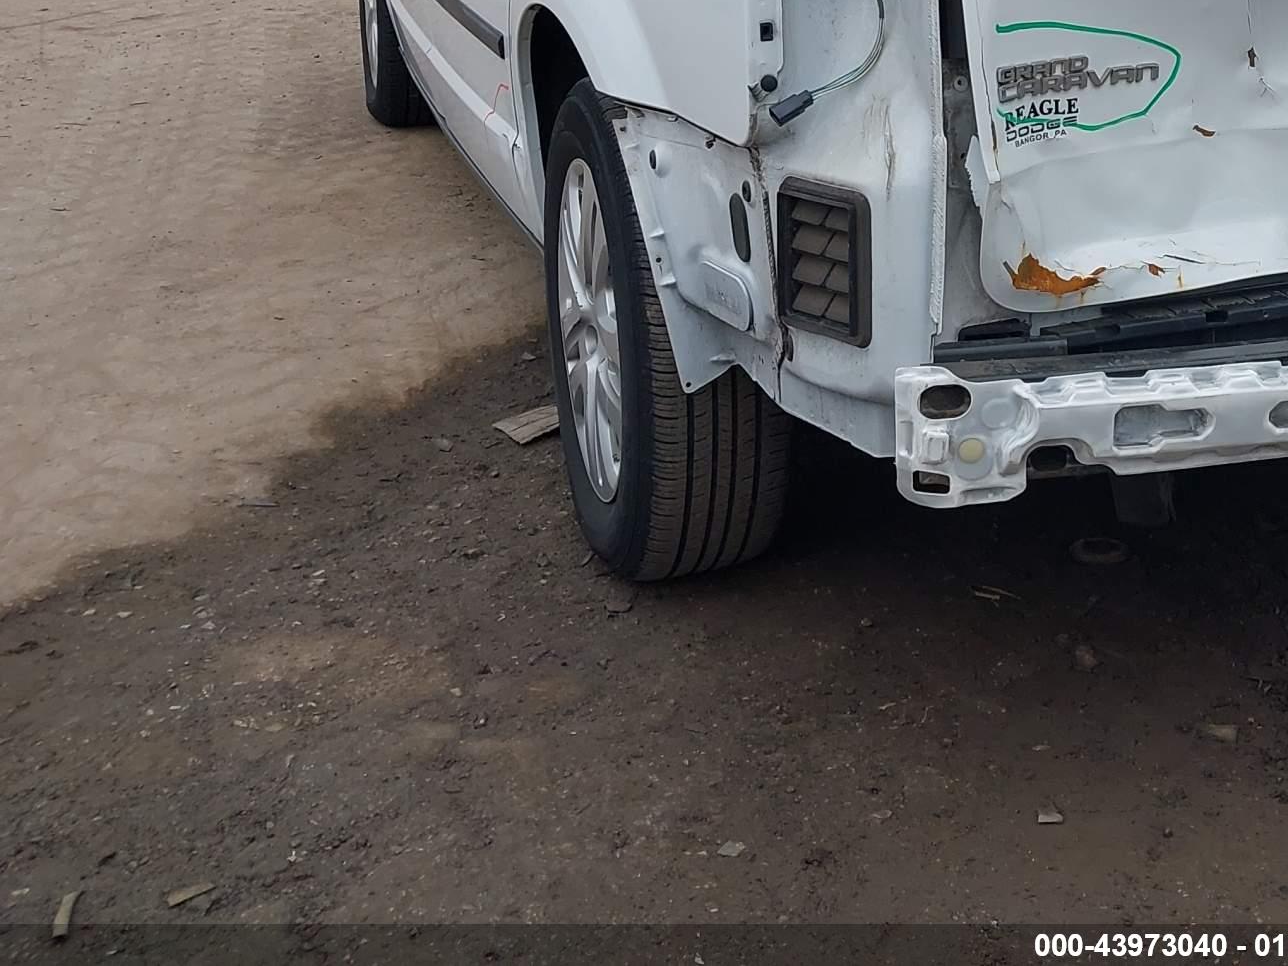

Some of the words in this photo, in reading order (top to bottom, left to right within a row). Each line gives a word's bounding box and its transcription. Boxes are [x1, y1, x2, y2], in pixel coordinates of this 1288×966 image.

[997, 54, 1089, 84] GRAND
[998, 62, 1160, 103] CARAVAN
[1004, 98, 1079, 132] REAGLE
[1006, 115, 1078, 143] DODGE
[1014, 132, 1049, 148] BANGOR
